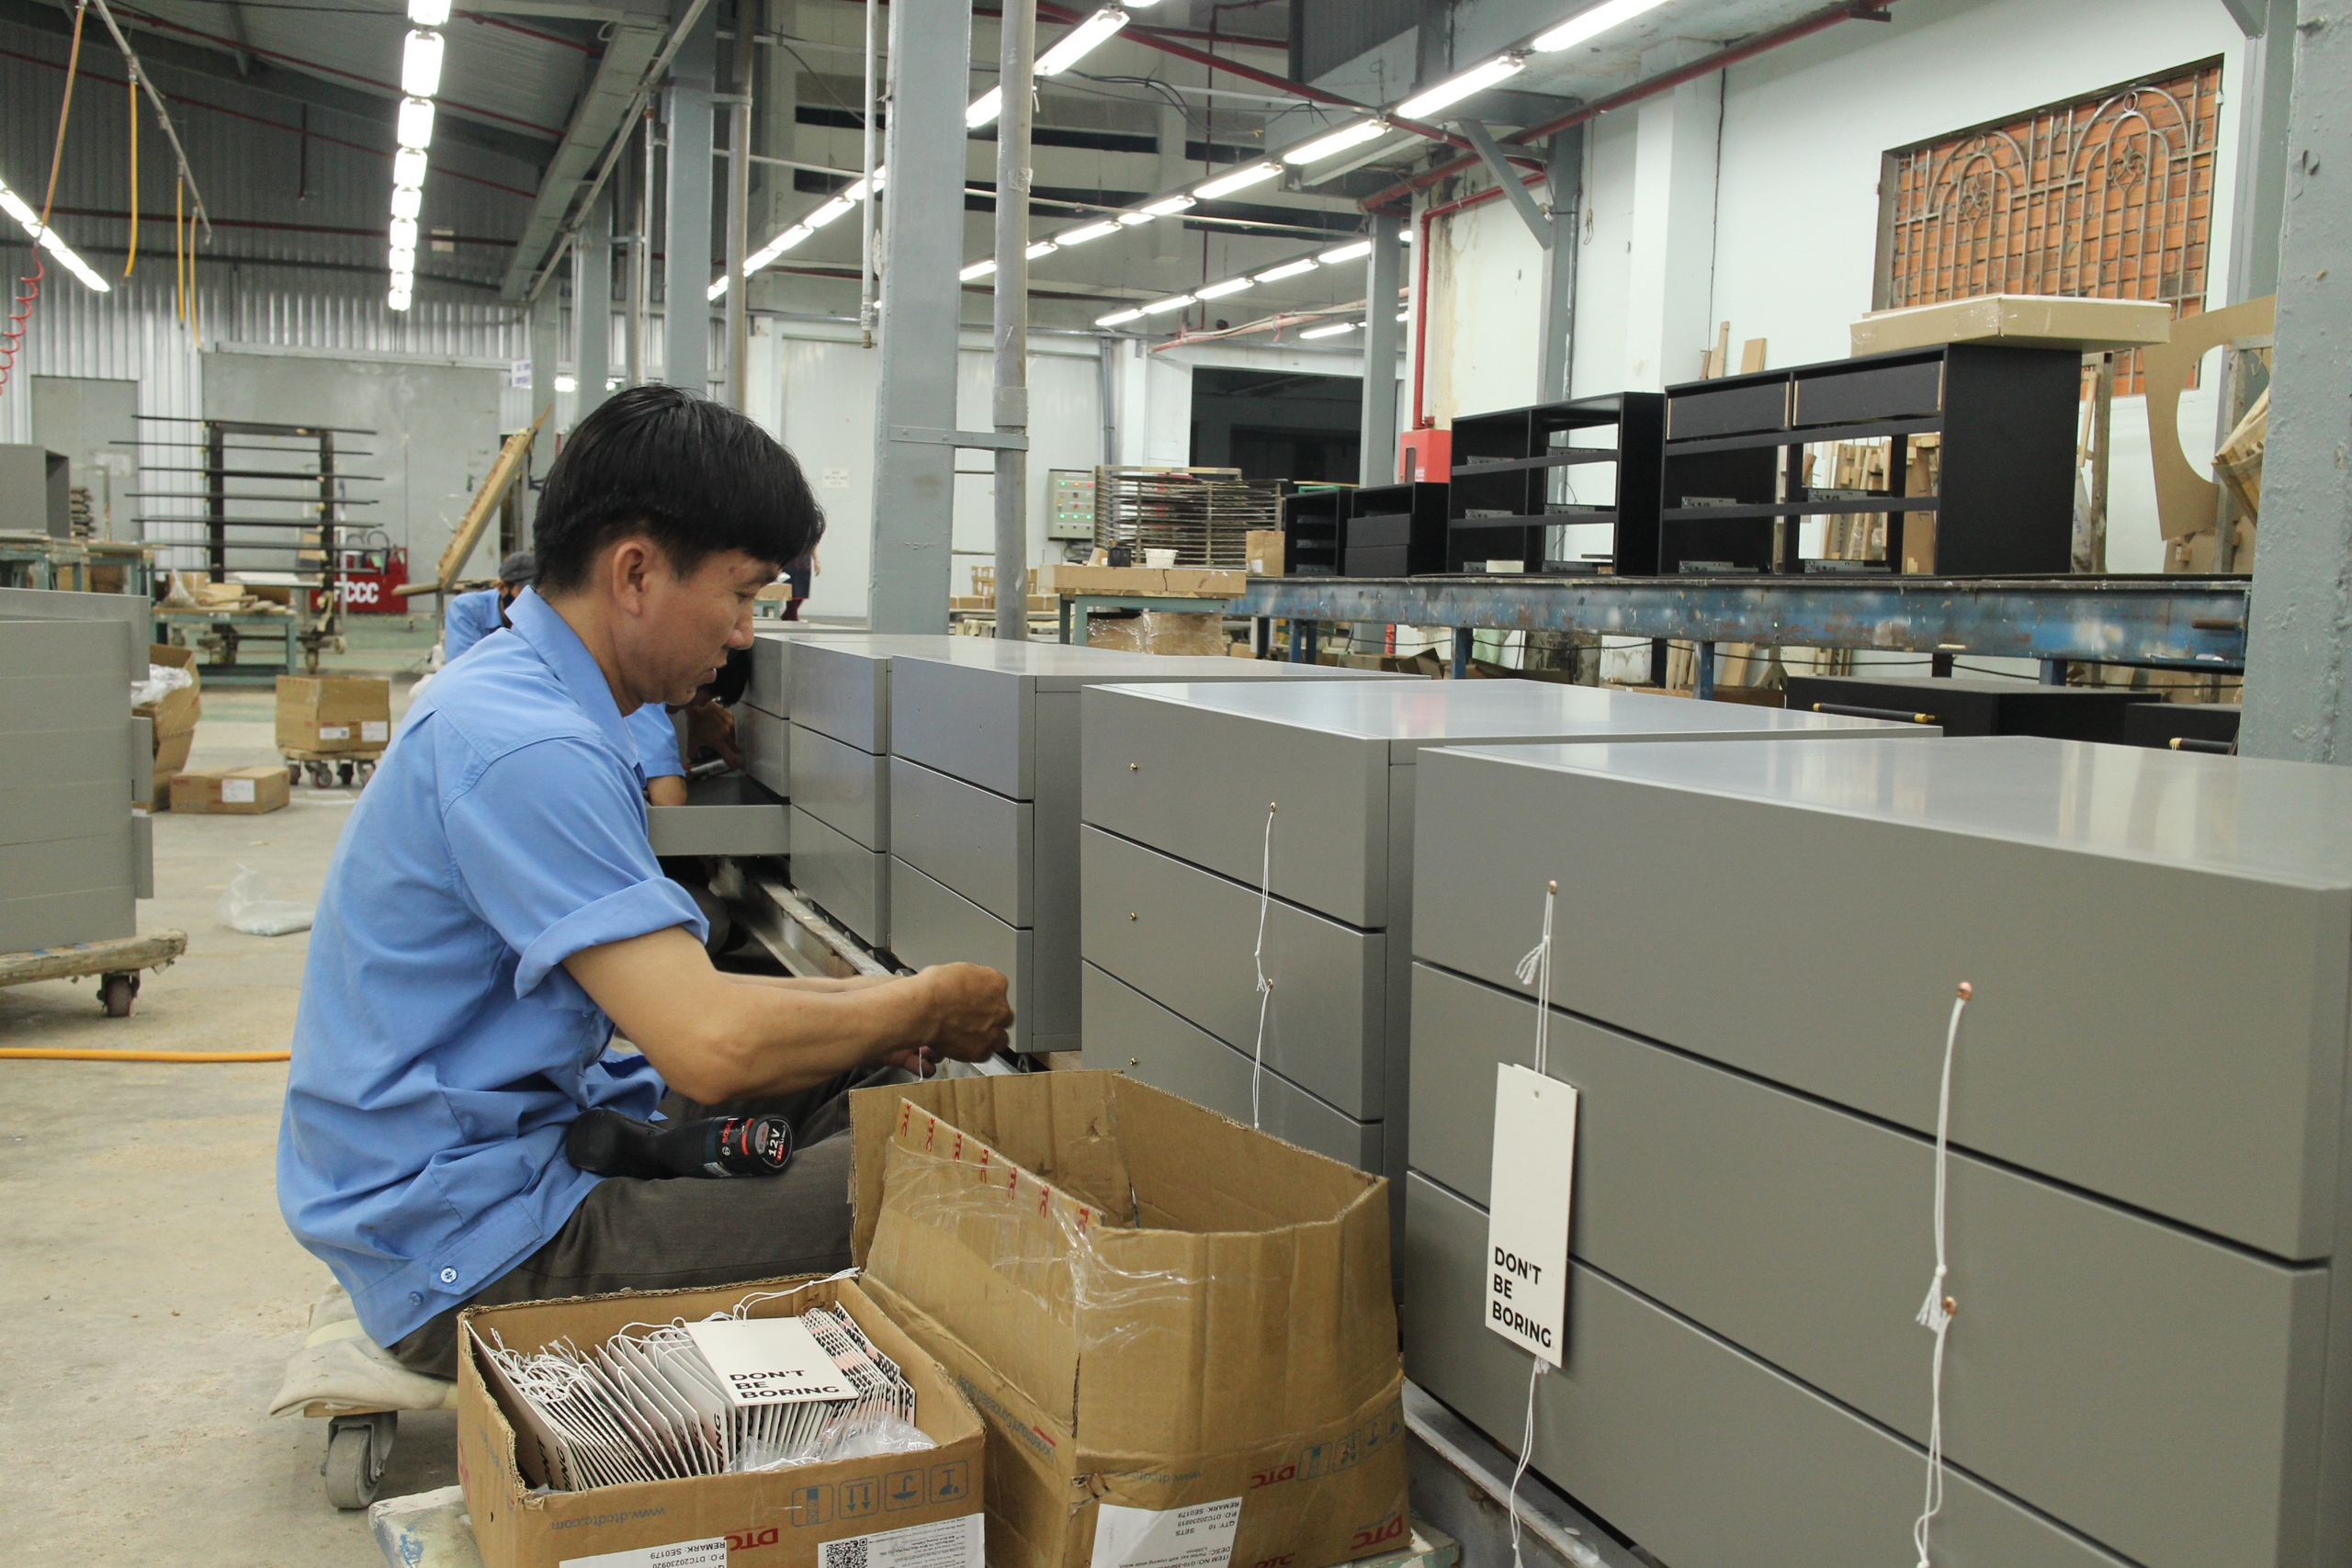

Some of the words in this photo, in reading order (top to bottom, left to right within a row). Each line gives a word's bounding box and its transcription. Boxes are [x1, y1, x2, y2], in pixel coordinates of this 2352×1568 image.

[768, 1128, 780, 1157] 12V
[1495, 1246, 1542, 1286] DON'T
[1494, 1273, 1512, 1300] BE
[729, 1370, 805, 1382] DON'T
[735, 1382, 769, 1390] BE
[1250, 1465, 1295, 1489] DTC
[1205, 1501, 1239, 1512] REMARK:
[551, 1506, 665, 1531] www.dtcdtc.com
[1178, 1508, 1204, 1518] SE0179
[1218, 1520, 1235, 1529] QTY:
[1175, 1528, 1194, 1536] SETS
[1351, 1514, 1404, 1551] DTC
[724, 1528, 779, 1552] DTC
[684, 1541, 726, 1554] REMARK:
[1209, 1547, 1231, 1556] DESC:
[650, 1548, 682, 1560] SE0179
[707, 1553, 724, 1562] P.O:
[1211, 1554, 1229, 1562] ITEM
[652, 1556, 706, 1568] DTC20230920
